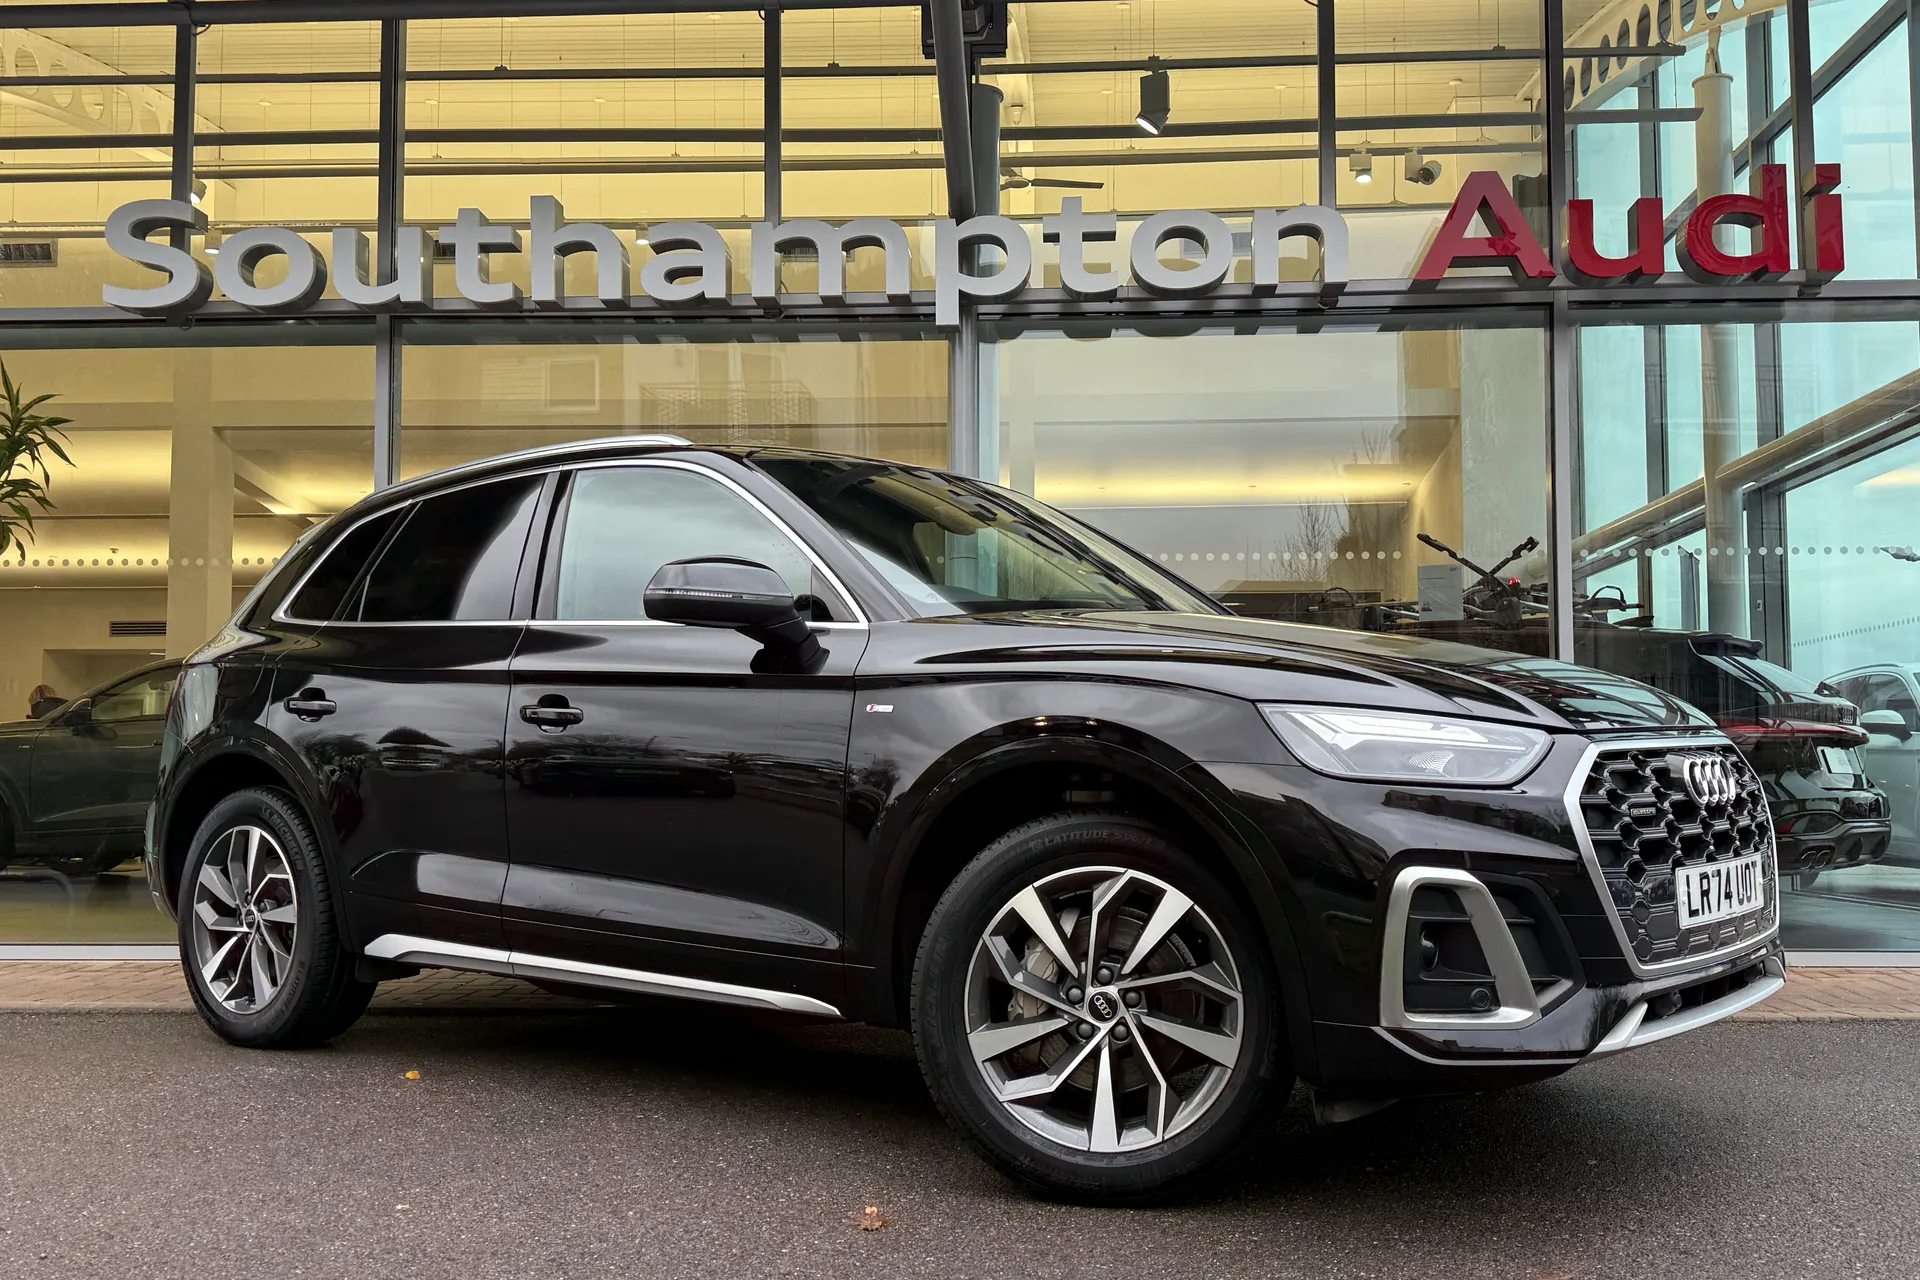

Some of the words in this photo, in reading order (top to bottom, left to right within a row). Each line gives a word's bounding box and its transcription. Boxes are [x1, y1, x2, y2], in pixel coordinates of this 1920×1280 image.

[102, 195, 1349, 326] Southampton
[1414, 163, 1845, 284] Audi
[1045, 829, 1110, 847] LATITUDE
[1686, 866, 1733, 918] LR74
[1735, 860, 1758, 906] UOT
